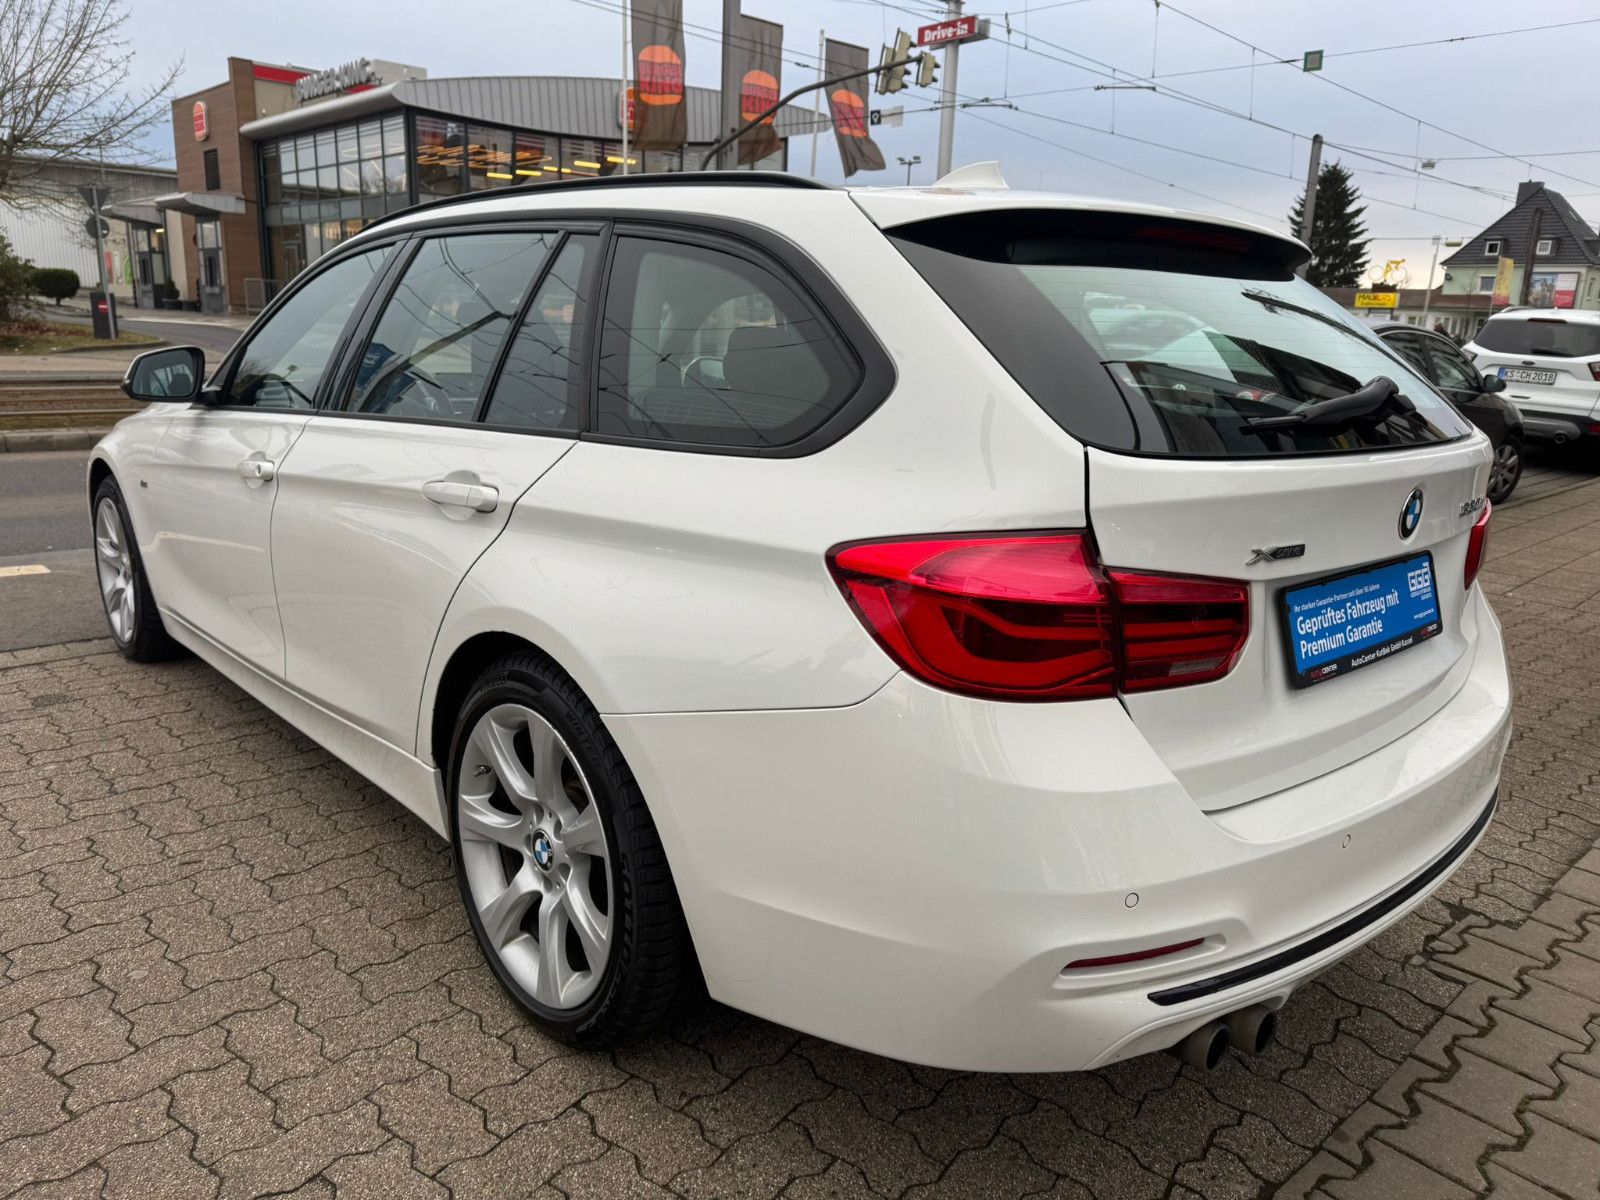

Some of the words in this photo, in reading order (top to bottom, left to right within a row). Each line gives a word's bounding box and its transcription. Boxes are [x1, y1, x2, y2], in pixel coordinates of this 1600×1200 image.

[923, 21, 969, 42] Drive-in
[1520, 371, 1532, 379] CH
[1297, 607, 1346, 636] Geprüftes
[1346, 599, 1386, 620] Fahrzeug
[1386, 588, 1400, 608] mit
[1300, 632, 1346, 659] Premium
[1346, 616, 1384, 643] Garantie
